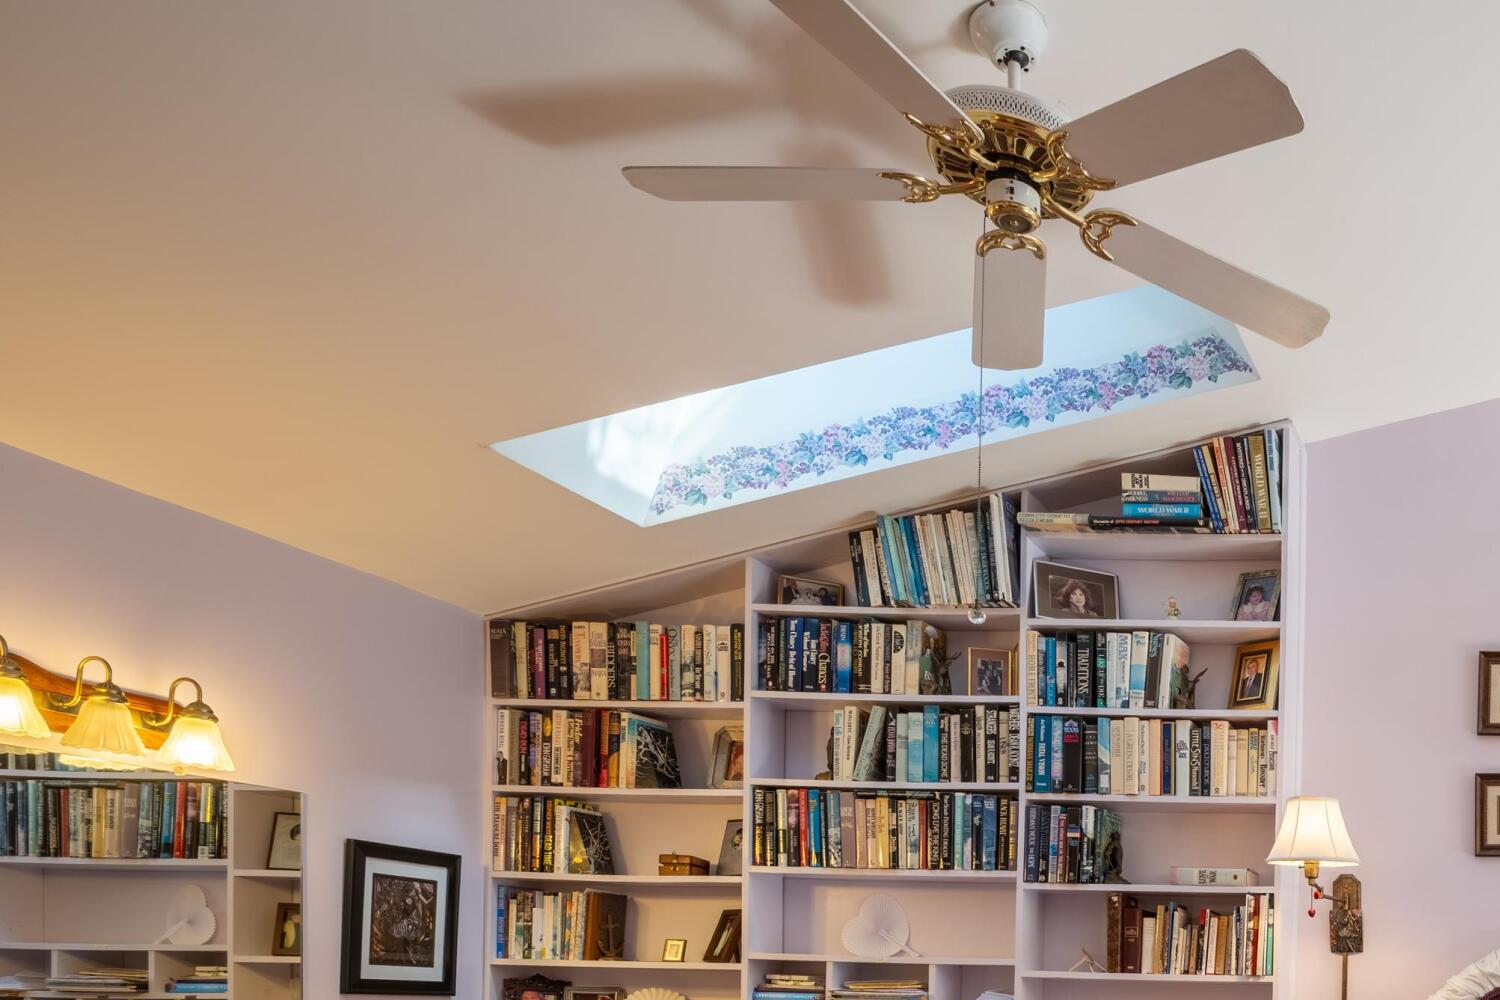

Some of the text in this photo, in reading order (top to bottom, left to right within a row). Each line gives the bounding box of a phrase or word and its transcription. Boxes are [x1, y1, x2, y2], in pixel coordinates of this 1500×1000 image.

[1254, 454, 1264, 486] WORLD
[1257, 488, 1266, 508] WAR
[790, 620, 798, 631] Tom
[788, 632, 798, 648] Clancy
[1118, 635, 1128, 660] MAX
[1150, 632, 1162, 658] Nurses
[788, 671, 796, 688] Honor
[818, 653, 829, 684] Chances
[1078, 648, 1089, 693] TRADITIONS
[986, 710, 996, 735] STRANGERS
[1191, 730, 1201, 766] LITTLE SINS
[755, 802, 764, 824] GRISHAM
[1000, 799, 1009, 836] BLACK HEART
[544, 835, 552, 850] DEAD
